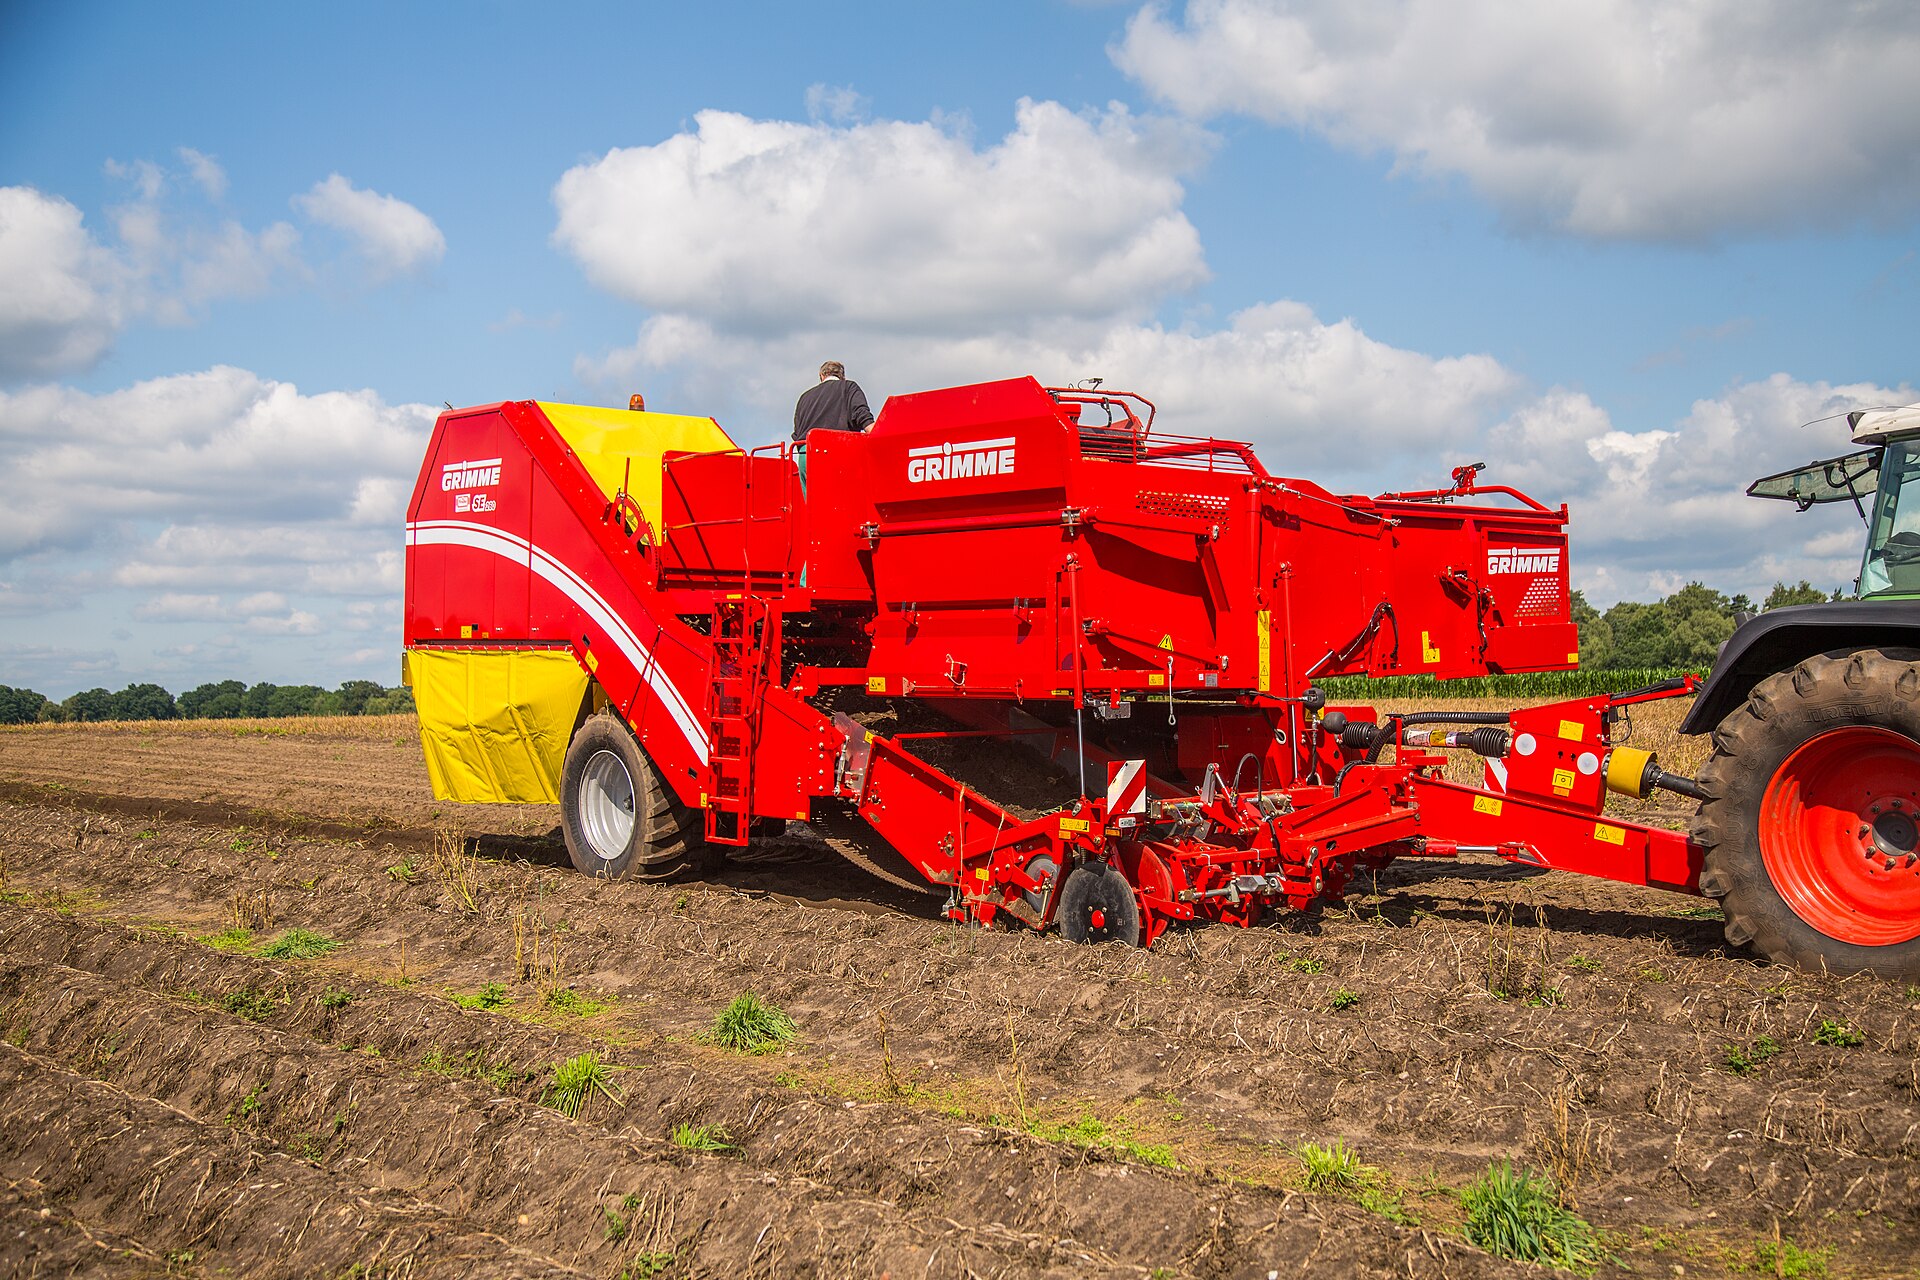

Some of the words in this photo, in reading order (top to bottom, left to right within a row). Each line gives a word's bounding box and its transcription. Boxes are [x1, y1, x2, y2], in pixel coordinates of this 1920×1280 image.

[442, 460, 502, 492] GRIMME
[908, 441, 1015, 483] GRIMME
[472, 495, 486, 512] SE
[1488, 547, 1560, 575] GRIMME
